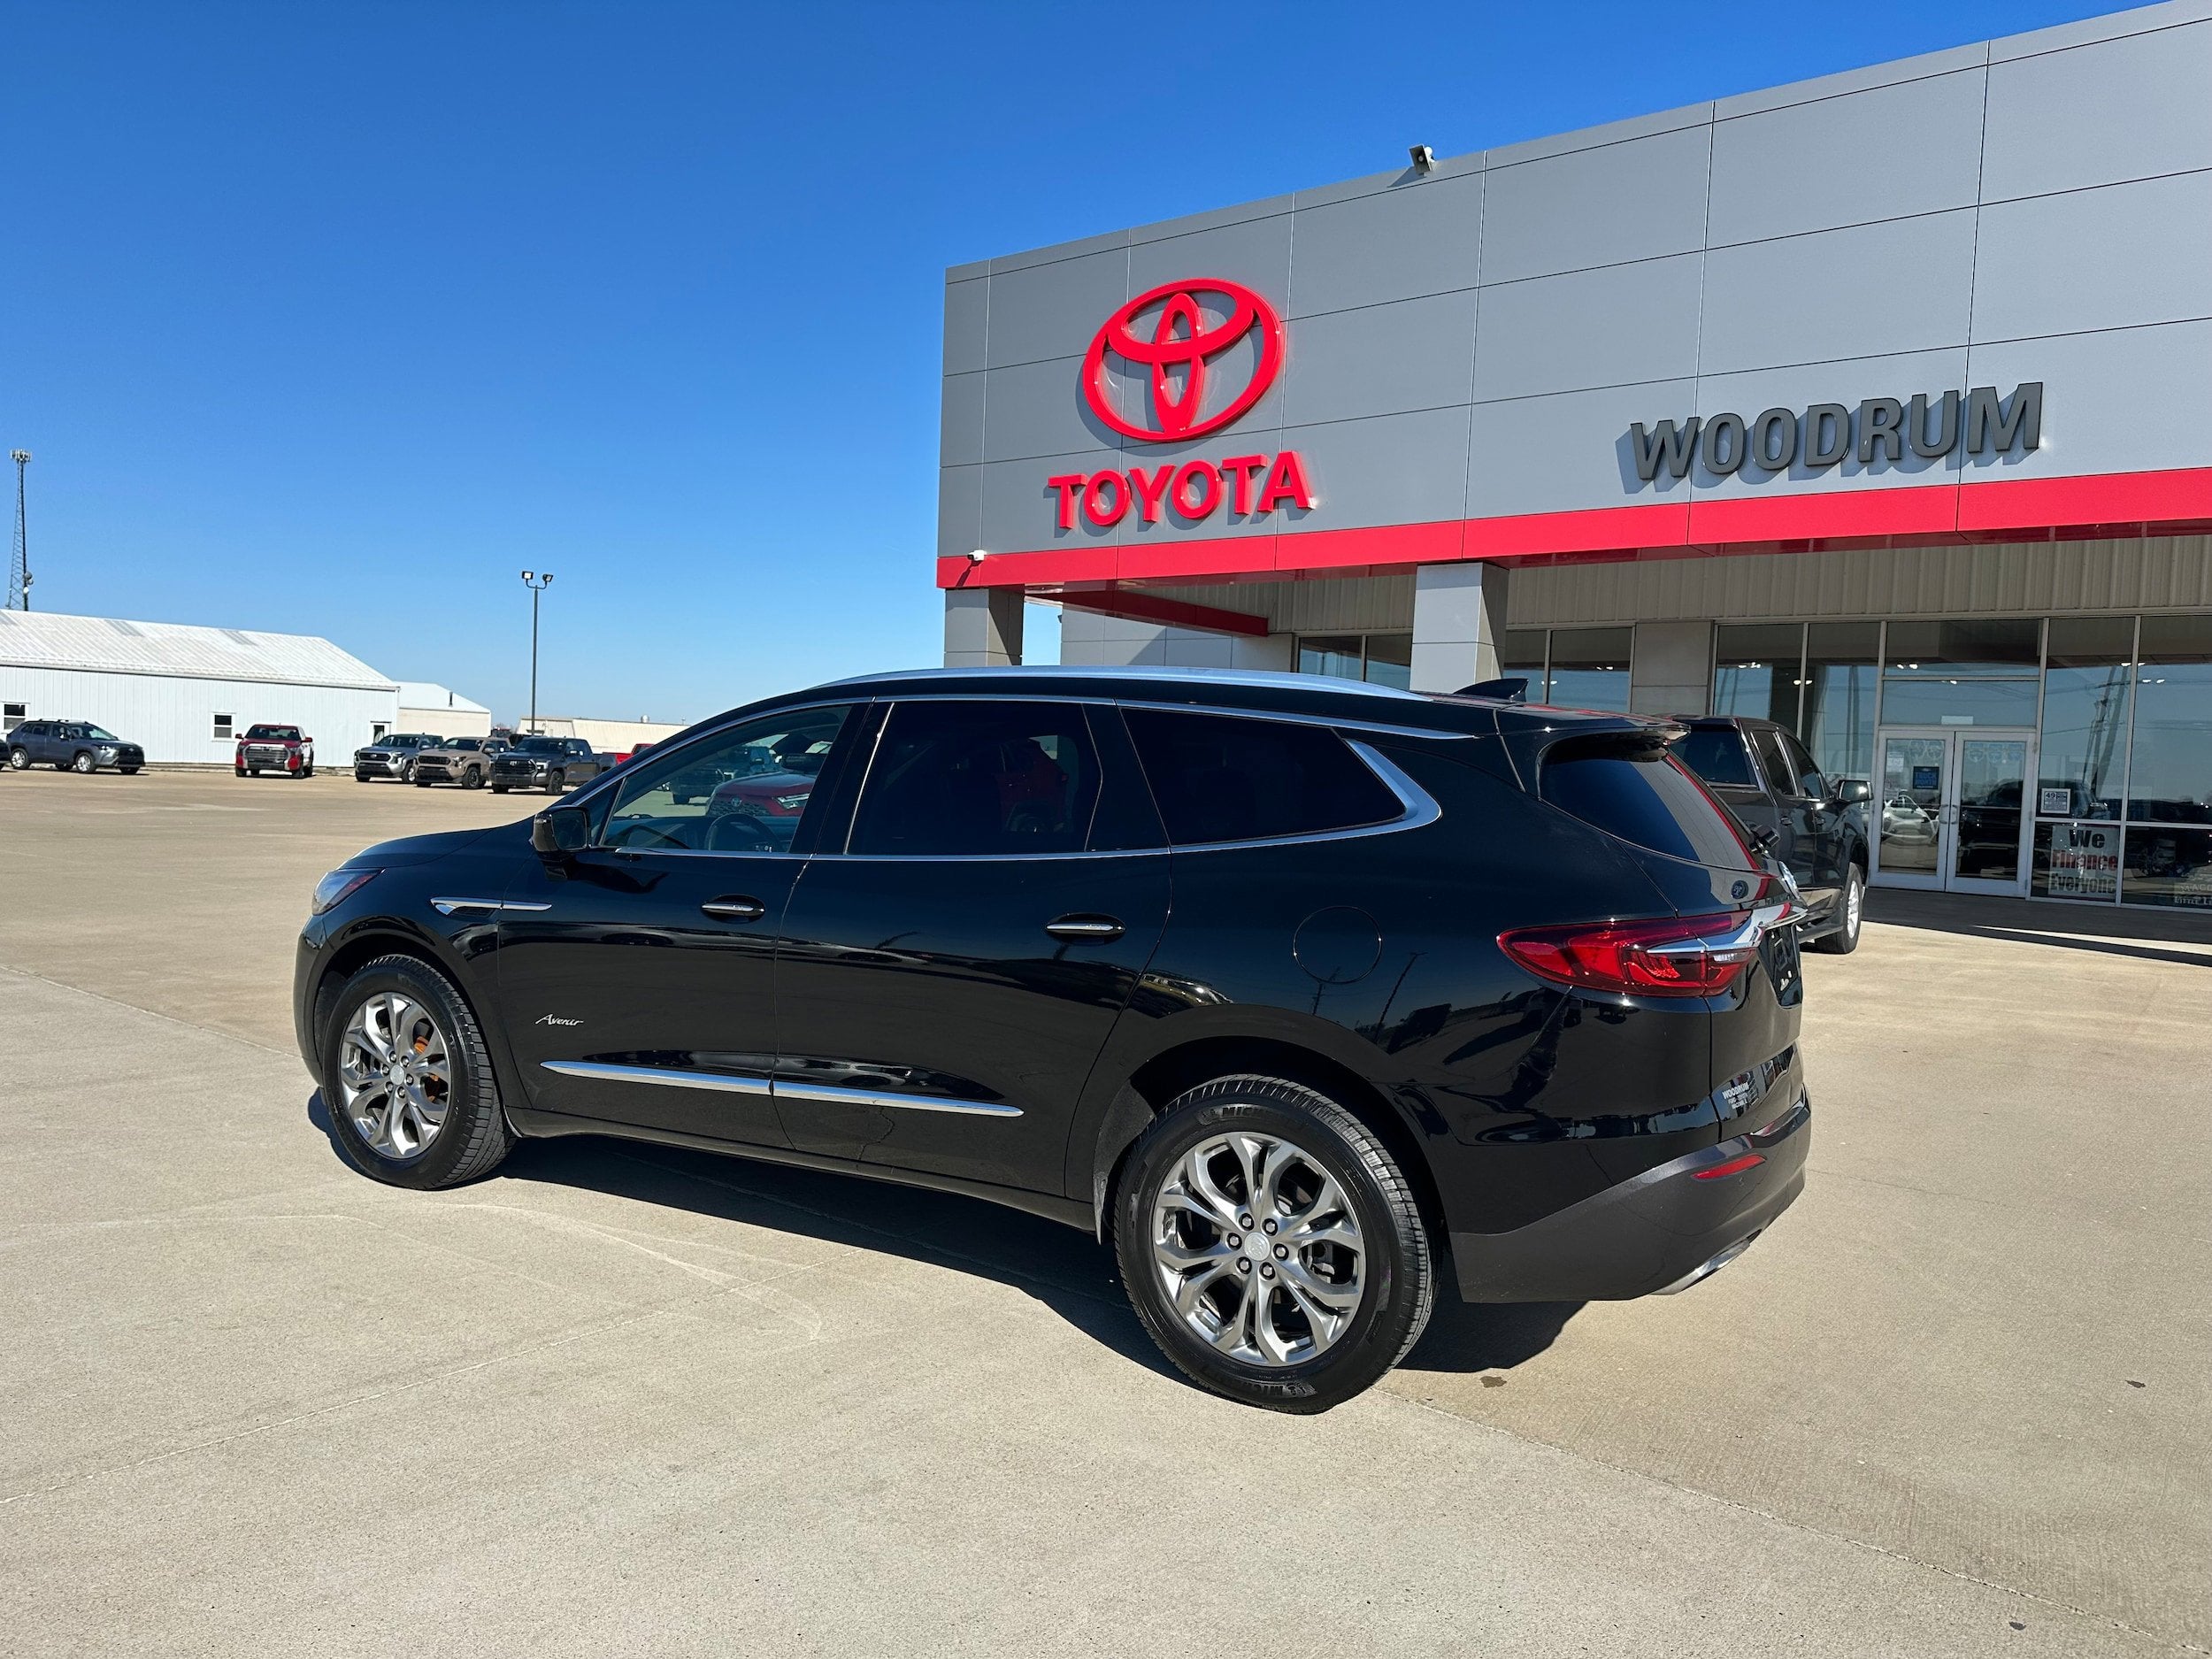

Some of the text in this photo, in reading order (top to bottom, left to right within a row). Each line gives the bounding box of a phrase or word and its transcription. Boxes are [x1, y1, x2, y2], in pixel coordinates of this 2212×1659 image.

[1630, 382, 2043, 480] WOODRUM
[1048, 450, 1316, 529] TOYOTA
[2069, 829, 2106, 849] We
[2052, 849, 2118, 871] Finance
[2050, 872, 2117, 894] Everyone
[534, 1013, 584, 1026] Avenir
